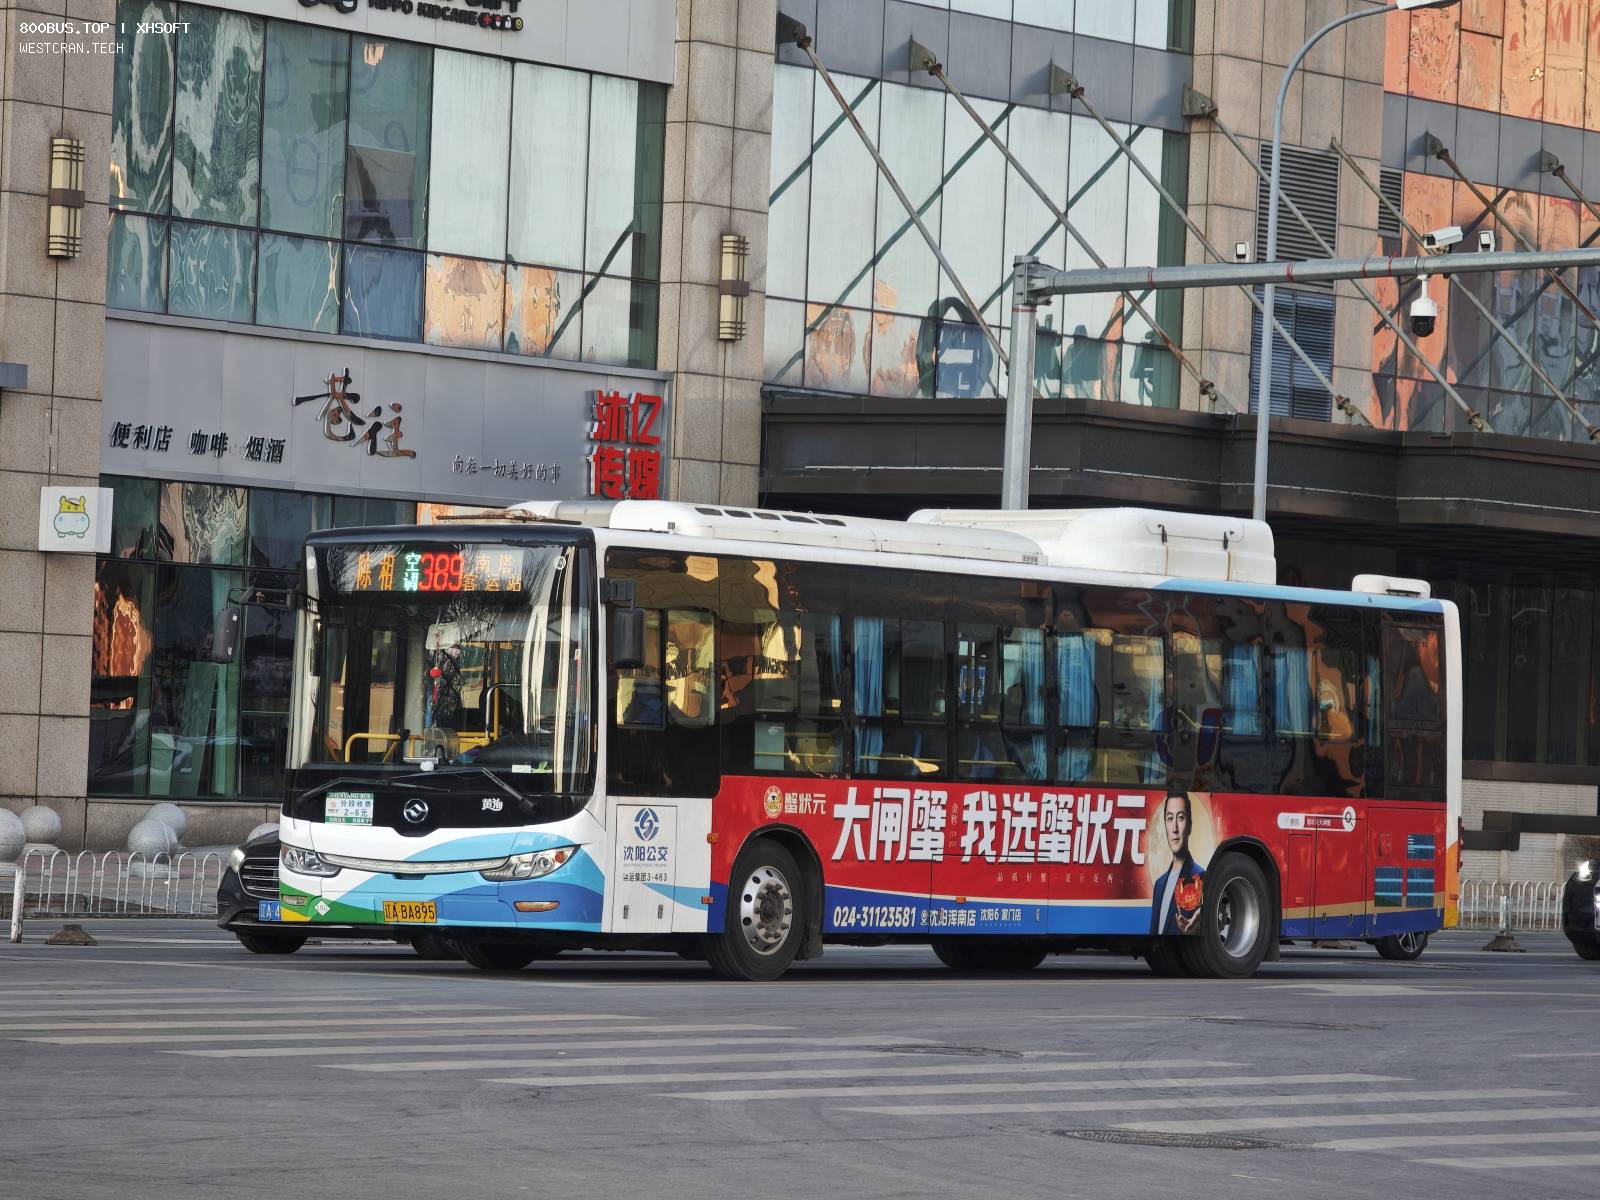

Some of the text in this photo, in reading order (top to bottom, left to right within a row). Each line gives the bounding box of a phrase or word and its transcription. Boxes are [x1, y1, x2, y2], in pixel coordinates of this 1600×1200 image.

[110, 421, 286, 464] 便利店 咖啡 烟酒
[451, 455, 561, 485] 向往一切美好的事
[588, 445, 662, 500] 传媒
[403, 552, 422, 592] 空调
[419, 552, 465, 592] 389
[462, 574, 523, 592] 客运站
[784, 793, 827, 816] 蟹状元
[831, 786, 1147, 866] 大闸蟹 我选蟹状元
[623, 846, 669, 862] 沈阳公交
[833, 906, 917, 928] 024-31123581
[929, 908, 977, 927] 沈阳浑南店
